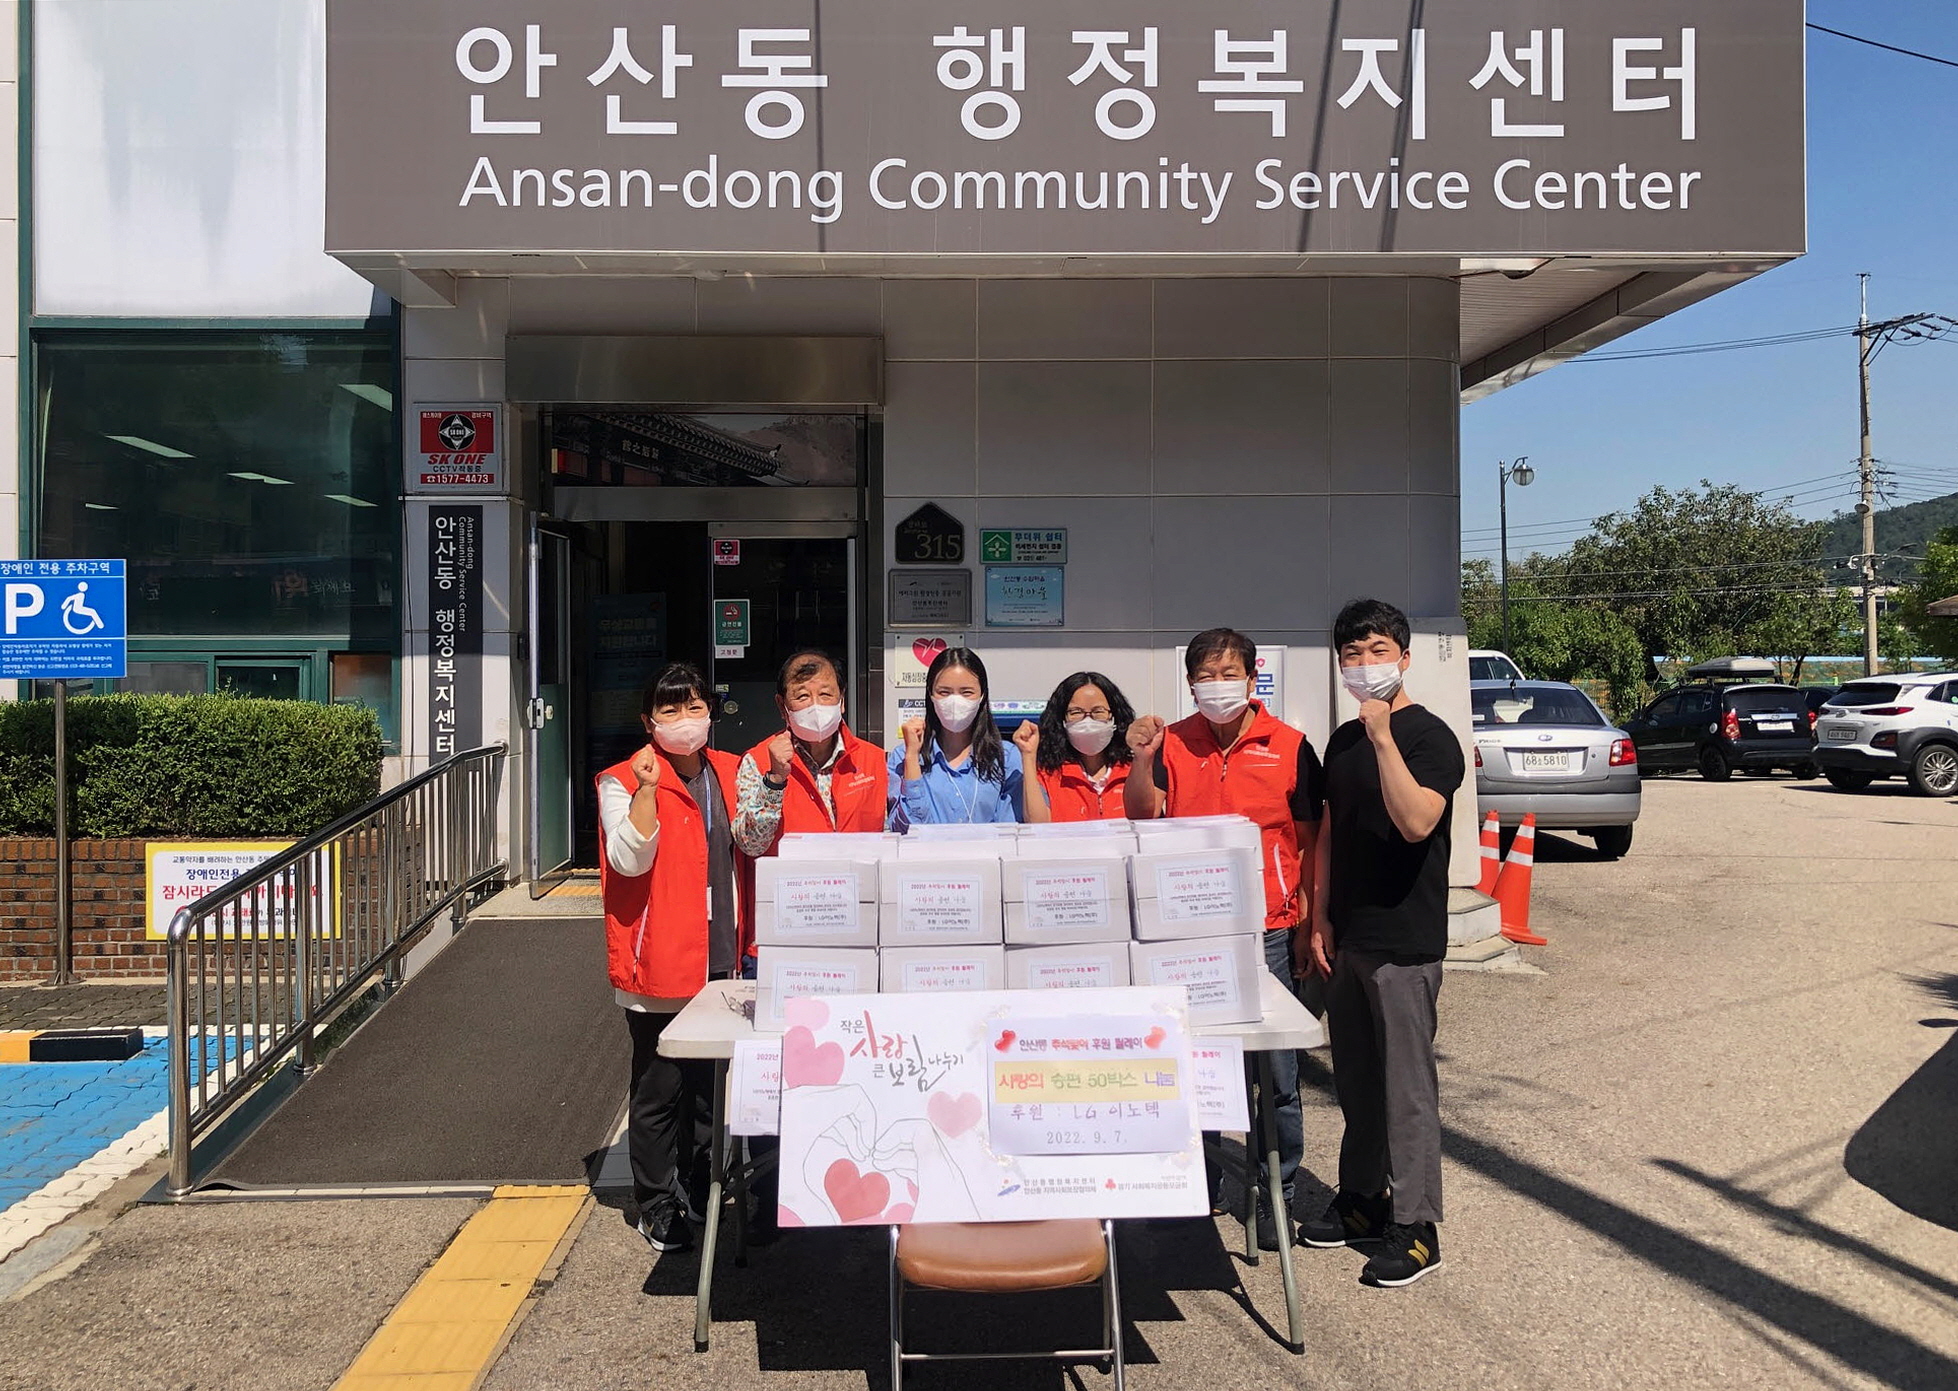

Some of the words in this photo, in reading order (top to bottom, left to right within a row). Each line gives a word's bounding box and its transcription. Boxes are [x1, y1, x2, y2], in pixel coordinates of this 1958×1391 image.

[455, 24, 828, 139] 안산동
[934, 26, 1696, 140] 행정복지센터
[459, 154, 843, 223] Ansan-dong
[870, 157, 1233, 224] Community
[1256, 157, 1470, 210] Service
[1494, 158, 1702, 210] Center
[427, 454, 452, 465] SK
[453, 454, 486, 465] ONE
[437, 474, 489, 483] 1577-4473
[434, 516, 457, 590] 안산동
[458, 516, 466, 567] Community
[466, 516, 474, 569] Ansan-dong
[914, 533, 962, 559] 315
[0, 562, 34, 575] 장애인
[39, 562, 61, 575] 전용
[66, 562, 110, 575] 주차구역
[5, 583, 45, 635] P
[434, 609, 457, 757] 행정복지센터
[186, 868, 241, 881] 장애인전용
[840, 1019, 865, 1034] 작은
[849, 1009, 908, 1059] 사랑
[1092, 1038, 1111, 1050] 후원
[1115, 1037, 1143, 1050] 릴레이
[761, 1071, 779, 1083] 사랑
[872, 1063, 885, 1079] 큰
[928, 1052, 964, 1071] 나누기
[998, 1073, 1045, 1090] 사랑의
[1050, 1072, 1081, 1089] 송편
[1087, 1072, 1138, 1088] 50박스
[1010, 1104, 1044, 1121] 후원
[1073, 1104, 1097, 1120] LG
[1108, 1101, 1160, 1120] 이노텍
[1046, 1130, 1086, 1145] 2022.
[1094, 1130, 1107, 1144] 9.
[1115, 1130, 1128, 1144] 7.
